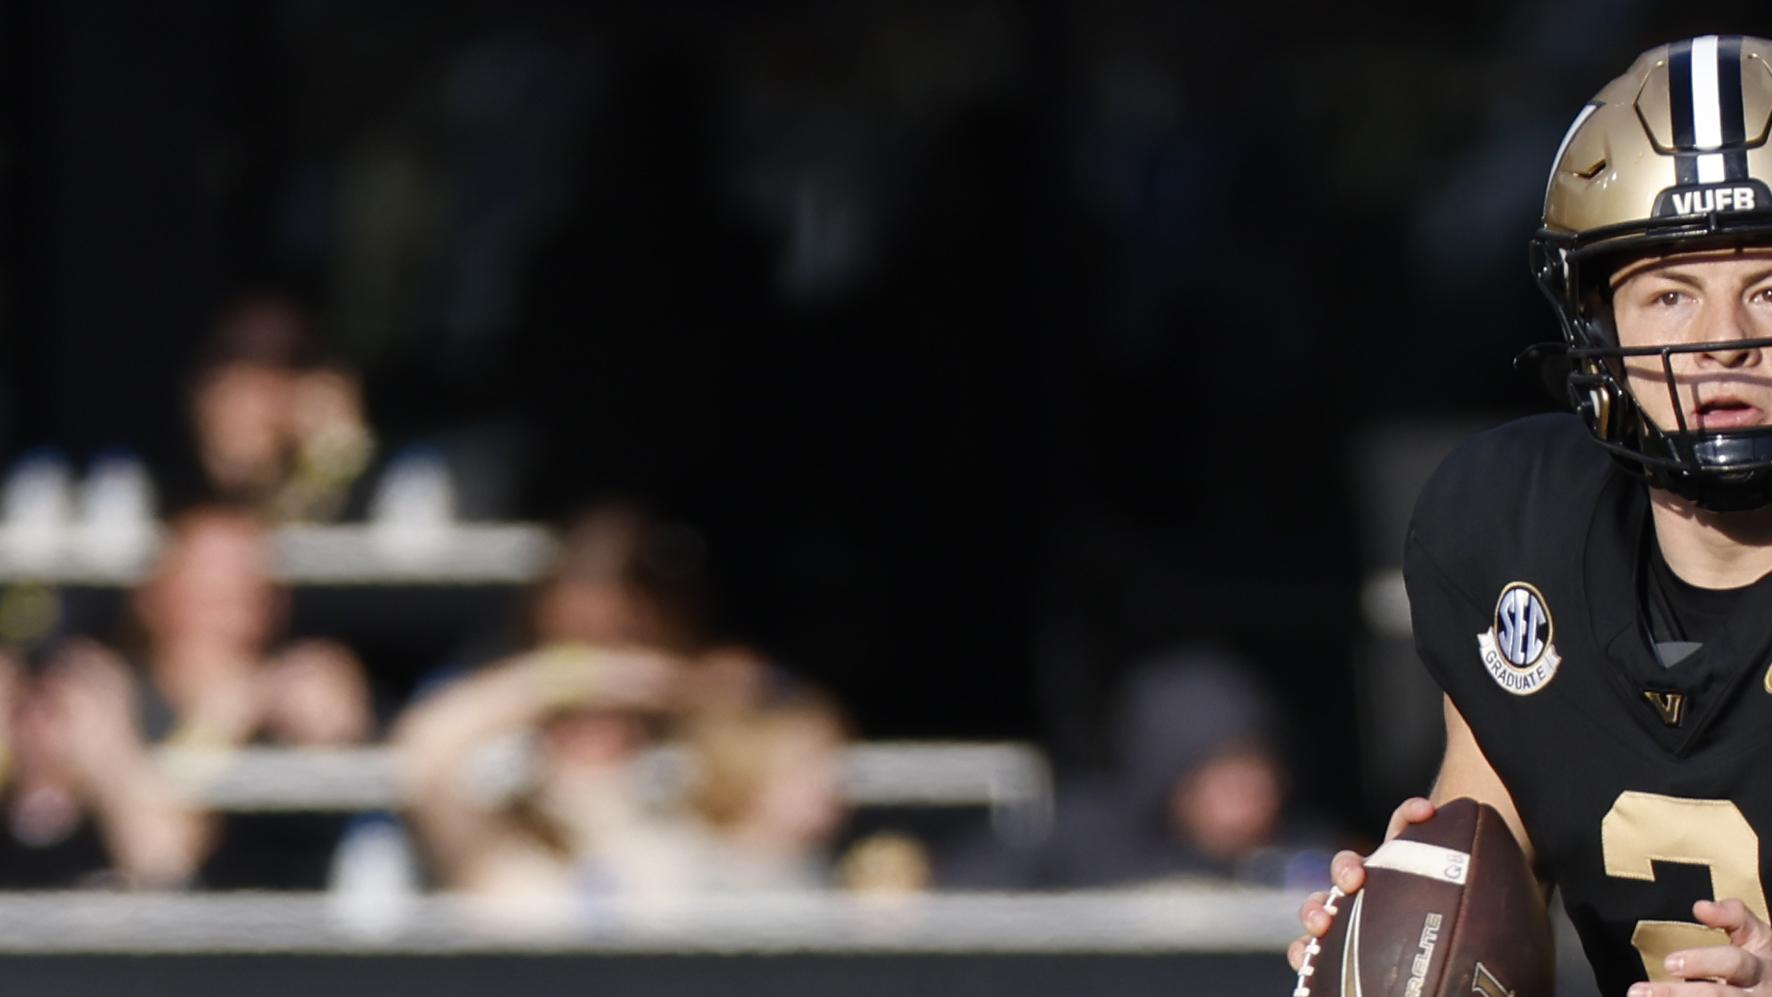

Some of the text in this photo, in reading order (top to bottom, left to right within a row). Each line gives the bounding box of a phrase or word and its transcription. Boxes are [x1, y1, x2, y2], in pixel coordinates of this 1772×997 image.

[1672, 187, 1755, 215] VUFB
[1499, 588, 1547, 665] SEC
[1486, 651, 1546, 690] GRADUATE
